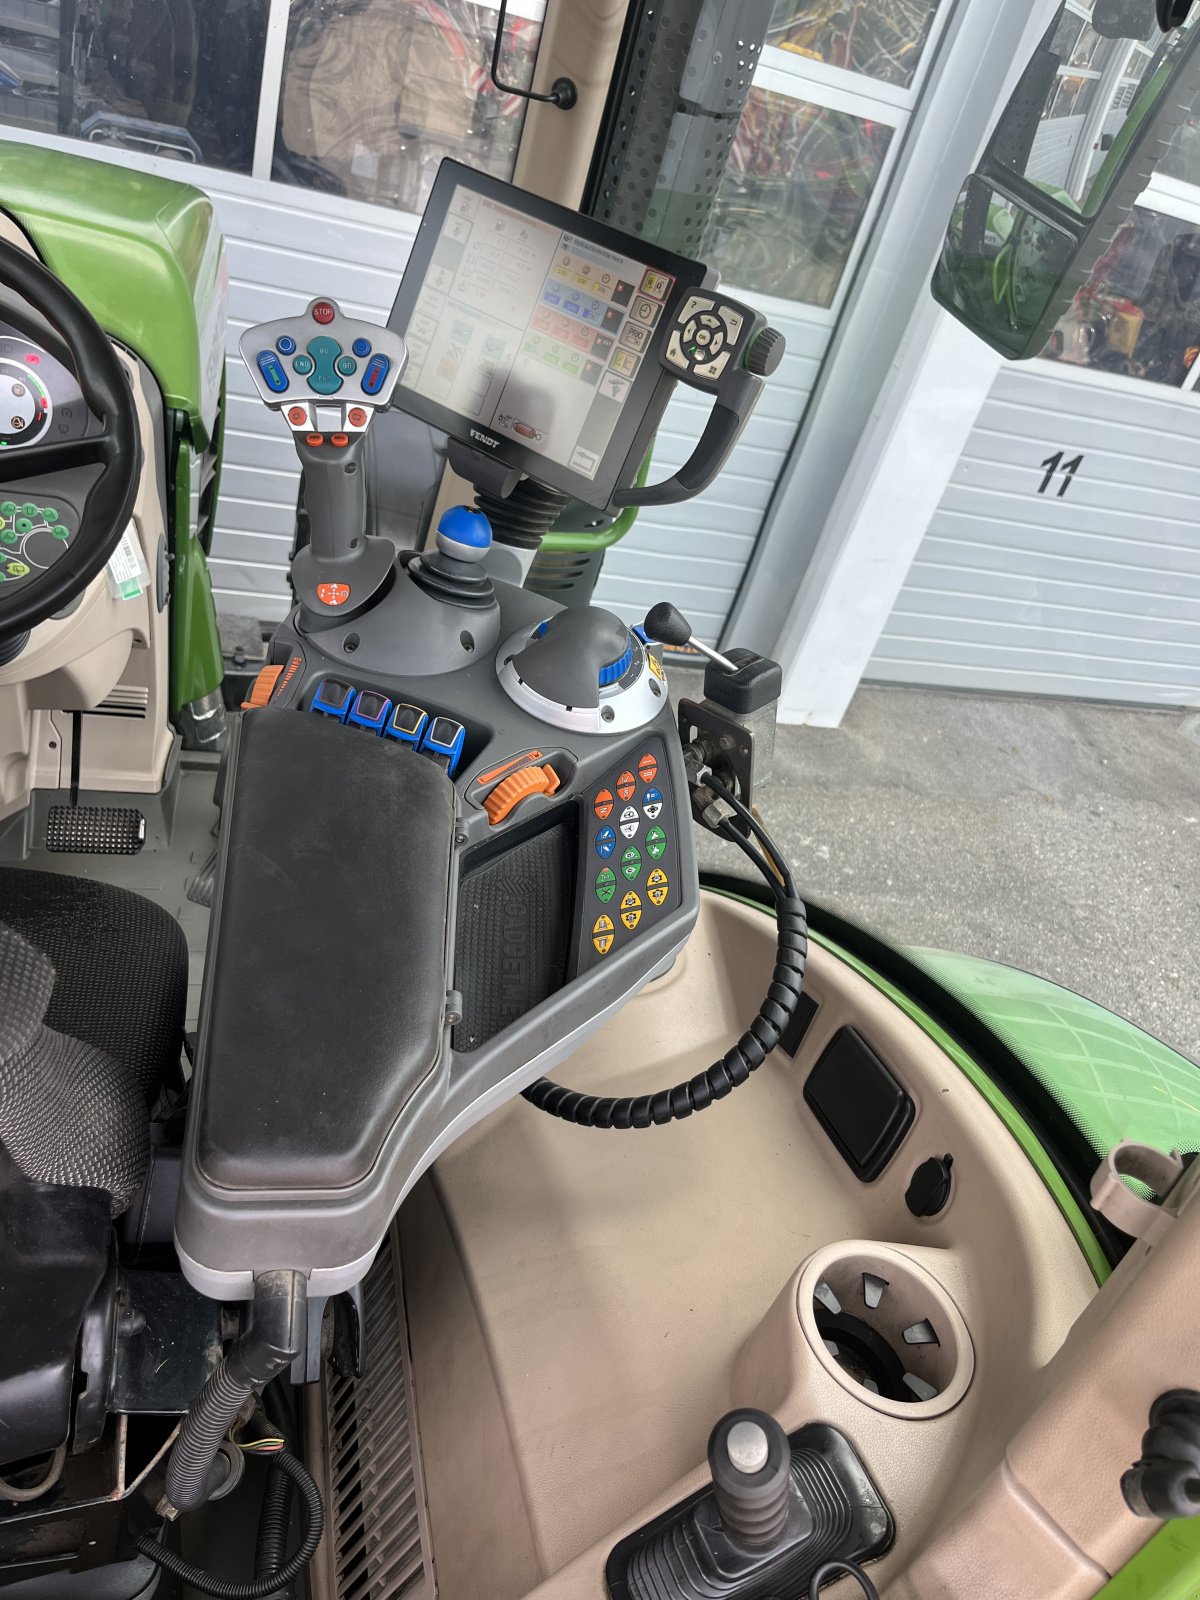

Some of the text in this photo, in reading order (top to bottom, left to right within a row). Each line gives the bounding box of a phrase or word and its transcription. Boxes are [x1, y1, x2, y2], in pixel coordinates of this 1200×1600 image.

[314, 308, 332, 316] STOP
[628, 328, 644, 340] PRIO
[470, 428, 501, 449] FENDT
[1037, 450, 1085, 498] 11
